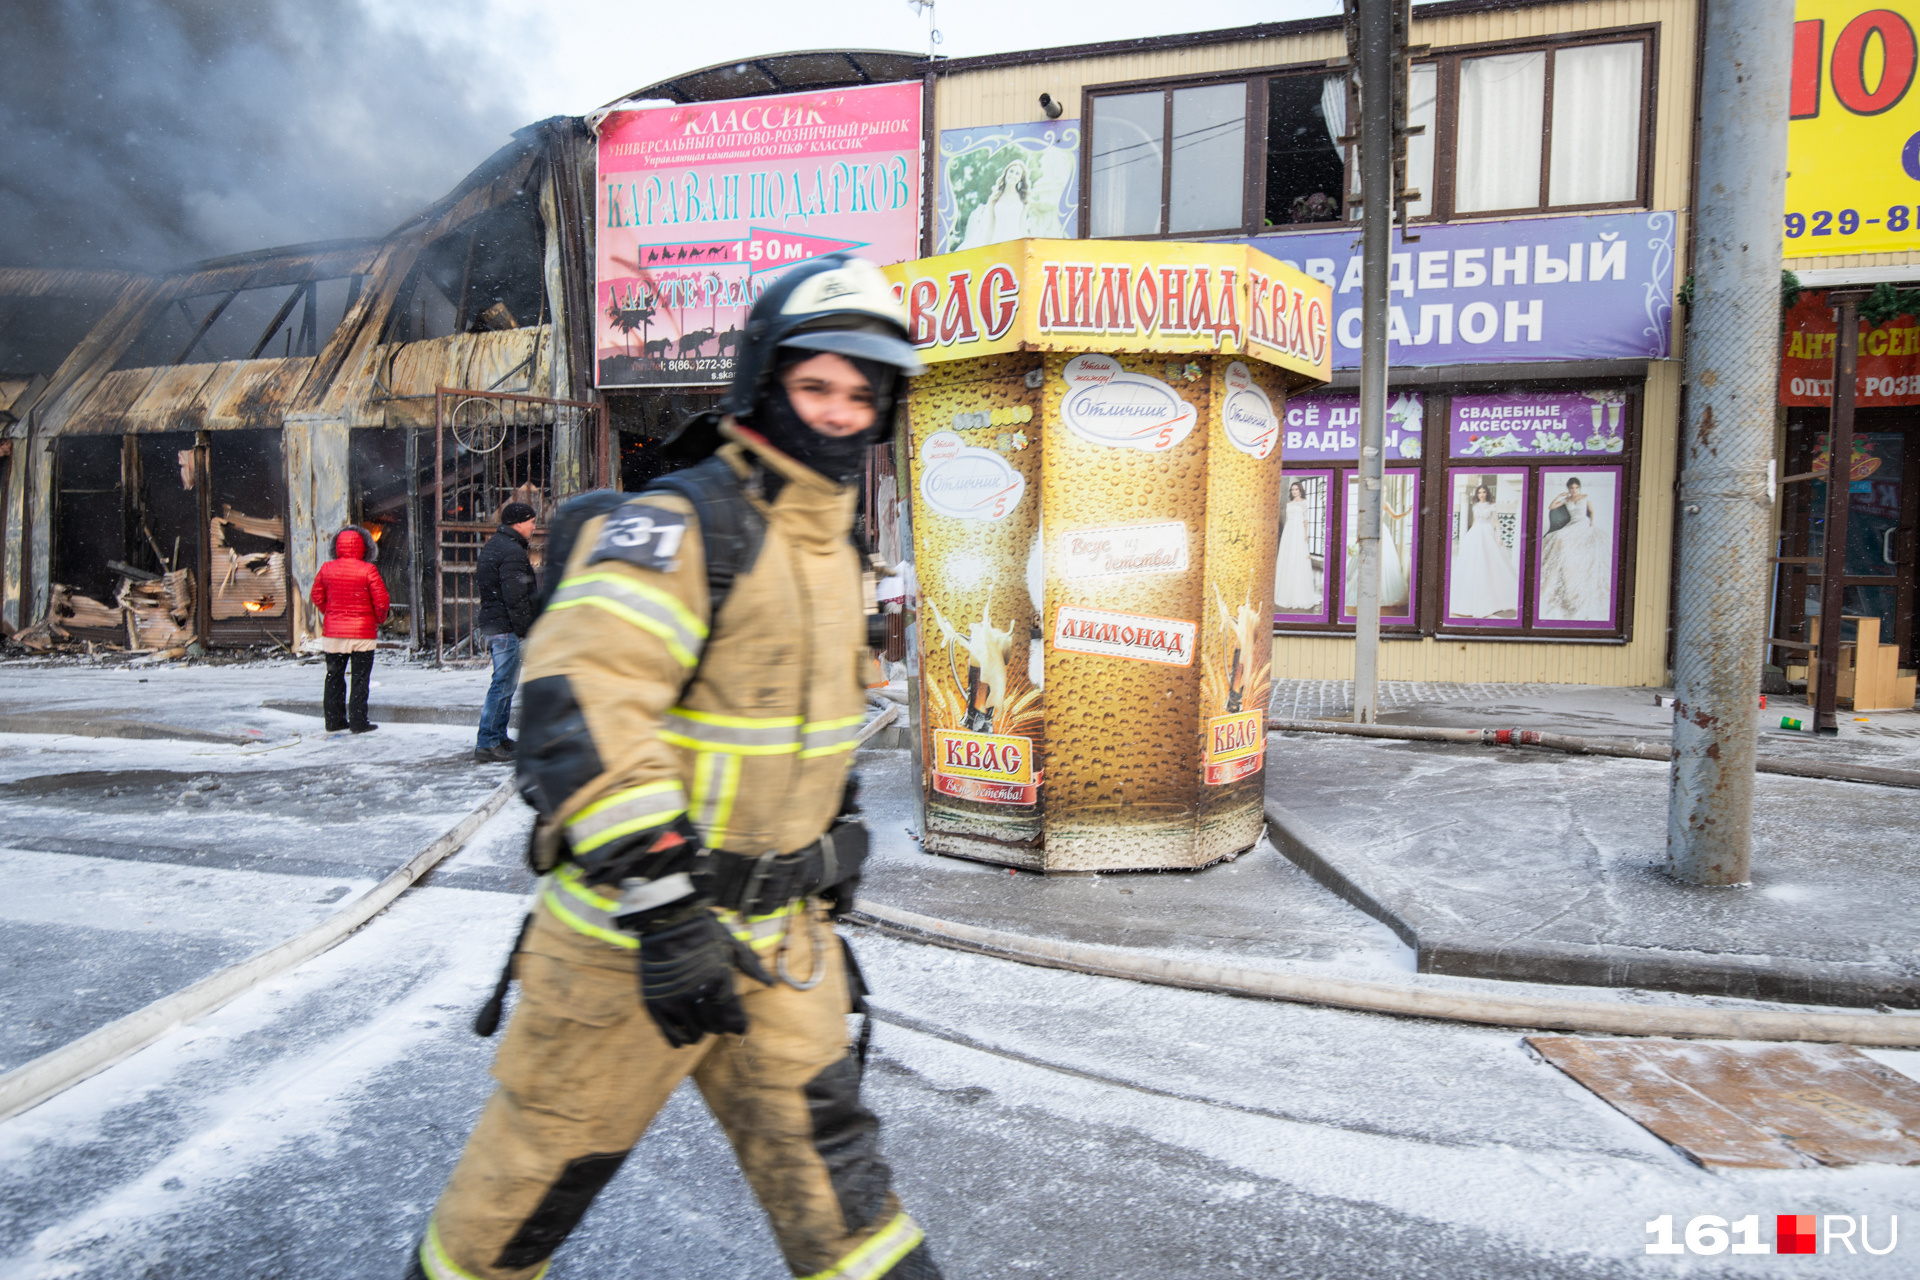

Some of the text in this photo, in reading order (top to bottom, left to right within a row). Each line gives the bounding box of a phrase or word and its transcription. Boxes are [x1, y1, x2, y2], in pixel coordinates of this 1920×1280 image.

[608, 119, 910, 158] УНИВЕРСАЛЬНЫЙ ОПТОВО-РОЗНИЧНЫЙ РЫНОК
[644, 151, 706, 168] Управляющая
[707, 149, 751, 161] компания
[752, 145, 777, 157] ООО
[606, 155, 909, 228] КАРАВАН ПОДАРКОВ
[1785, 205, 1920, 239] 929-8
[1281, 231, 1627, 298] ВАДЕБНЫЙ
[604, 277, 699, 315] ДАРИТЕ
[889, 263, 1019, 350] ВАС
[1038, 261, 1243, 351] ЛИМОНАД
[1248, 267, 1327, 366] КВАС
[1075, 397, 1168, 418] Отличник
[1284, 405, 1320, 427] СЁ
[1459, 405, 1561, 419] СВАДЕБНЫЕ
[1155, 428, 1174, 448] 5
[1459, 419, 1568, 432] АКСЕССУАРЫ
[931, 474, 1002, 492] Отличник
[1071, 537, 1139, 562] Вкус из
[1105, 548, 1179, 572] детства!
[1062, 618, 1185, 657] ЛИМОНАД
[1213, 718, 1257, 755] КВАС
[944, 738, 1021, 774] КВАС
[945, 778, 1024, 801] Вкус детства!
